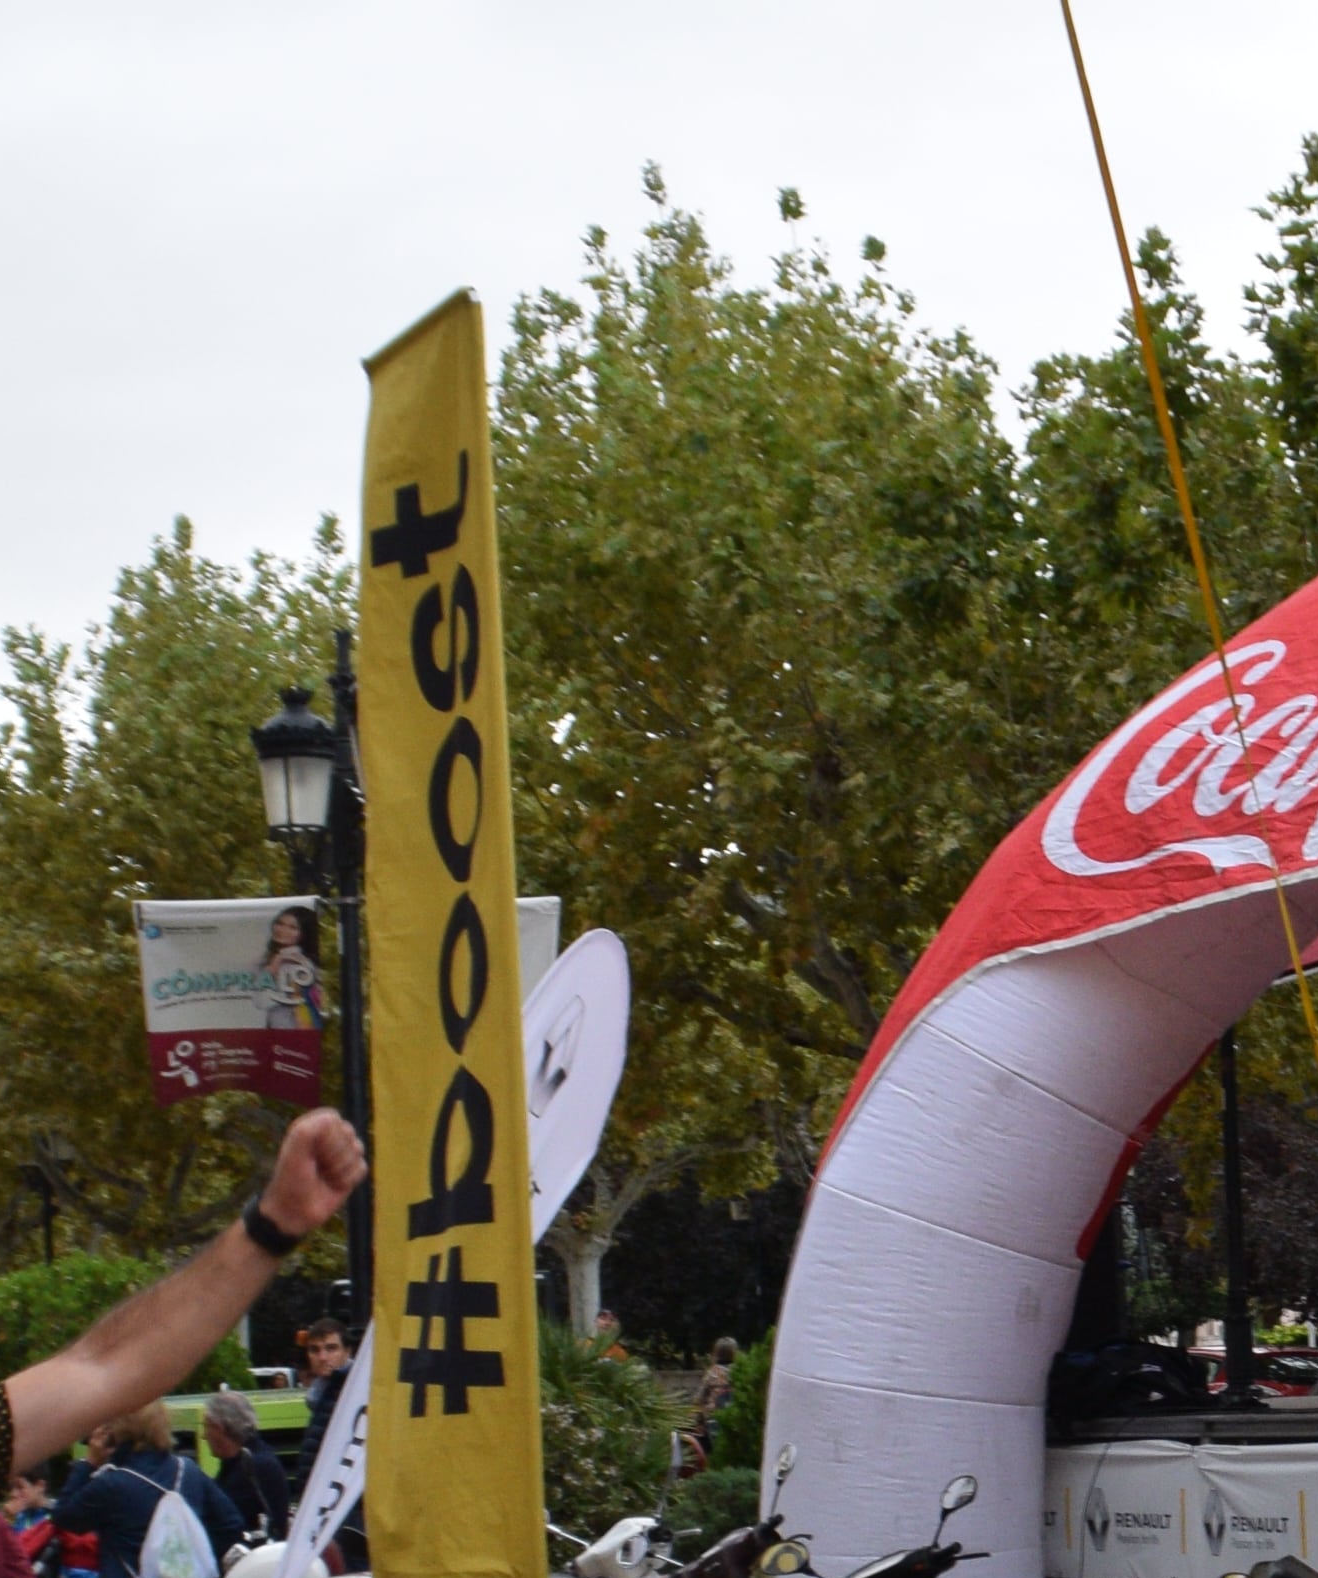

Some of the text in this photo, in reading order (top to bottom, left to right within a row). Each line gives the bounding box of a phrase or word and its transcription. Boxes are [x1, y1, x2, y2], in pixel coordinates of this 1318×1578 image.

[370, 449, 505, 1418] #boost
[1115, 1512, 1172, 1530] RENAULT
[1231, 1515, 1290, 1535] RENAULT
